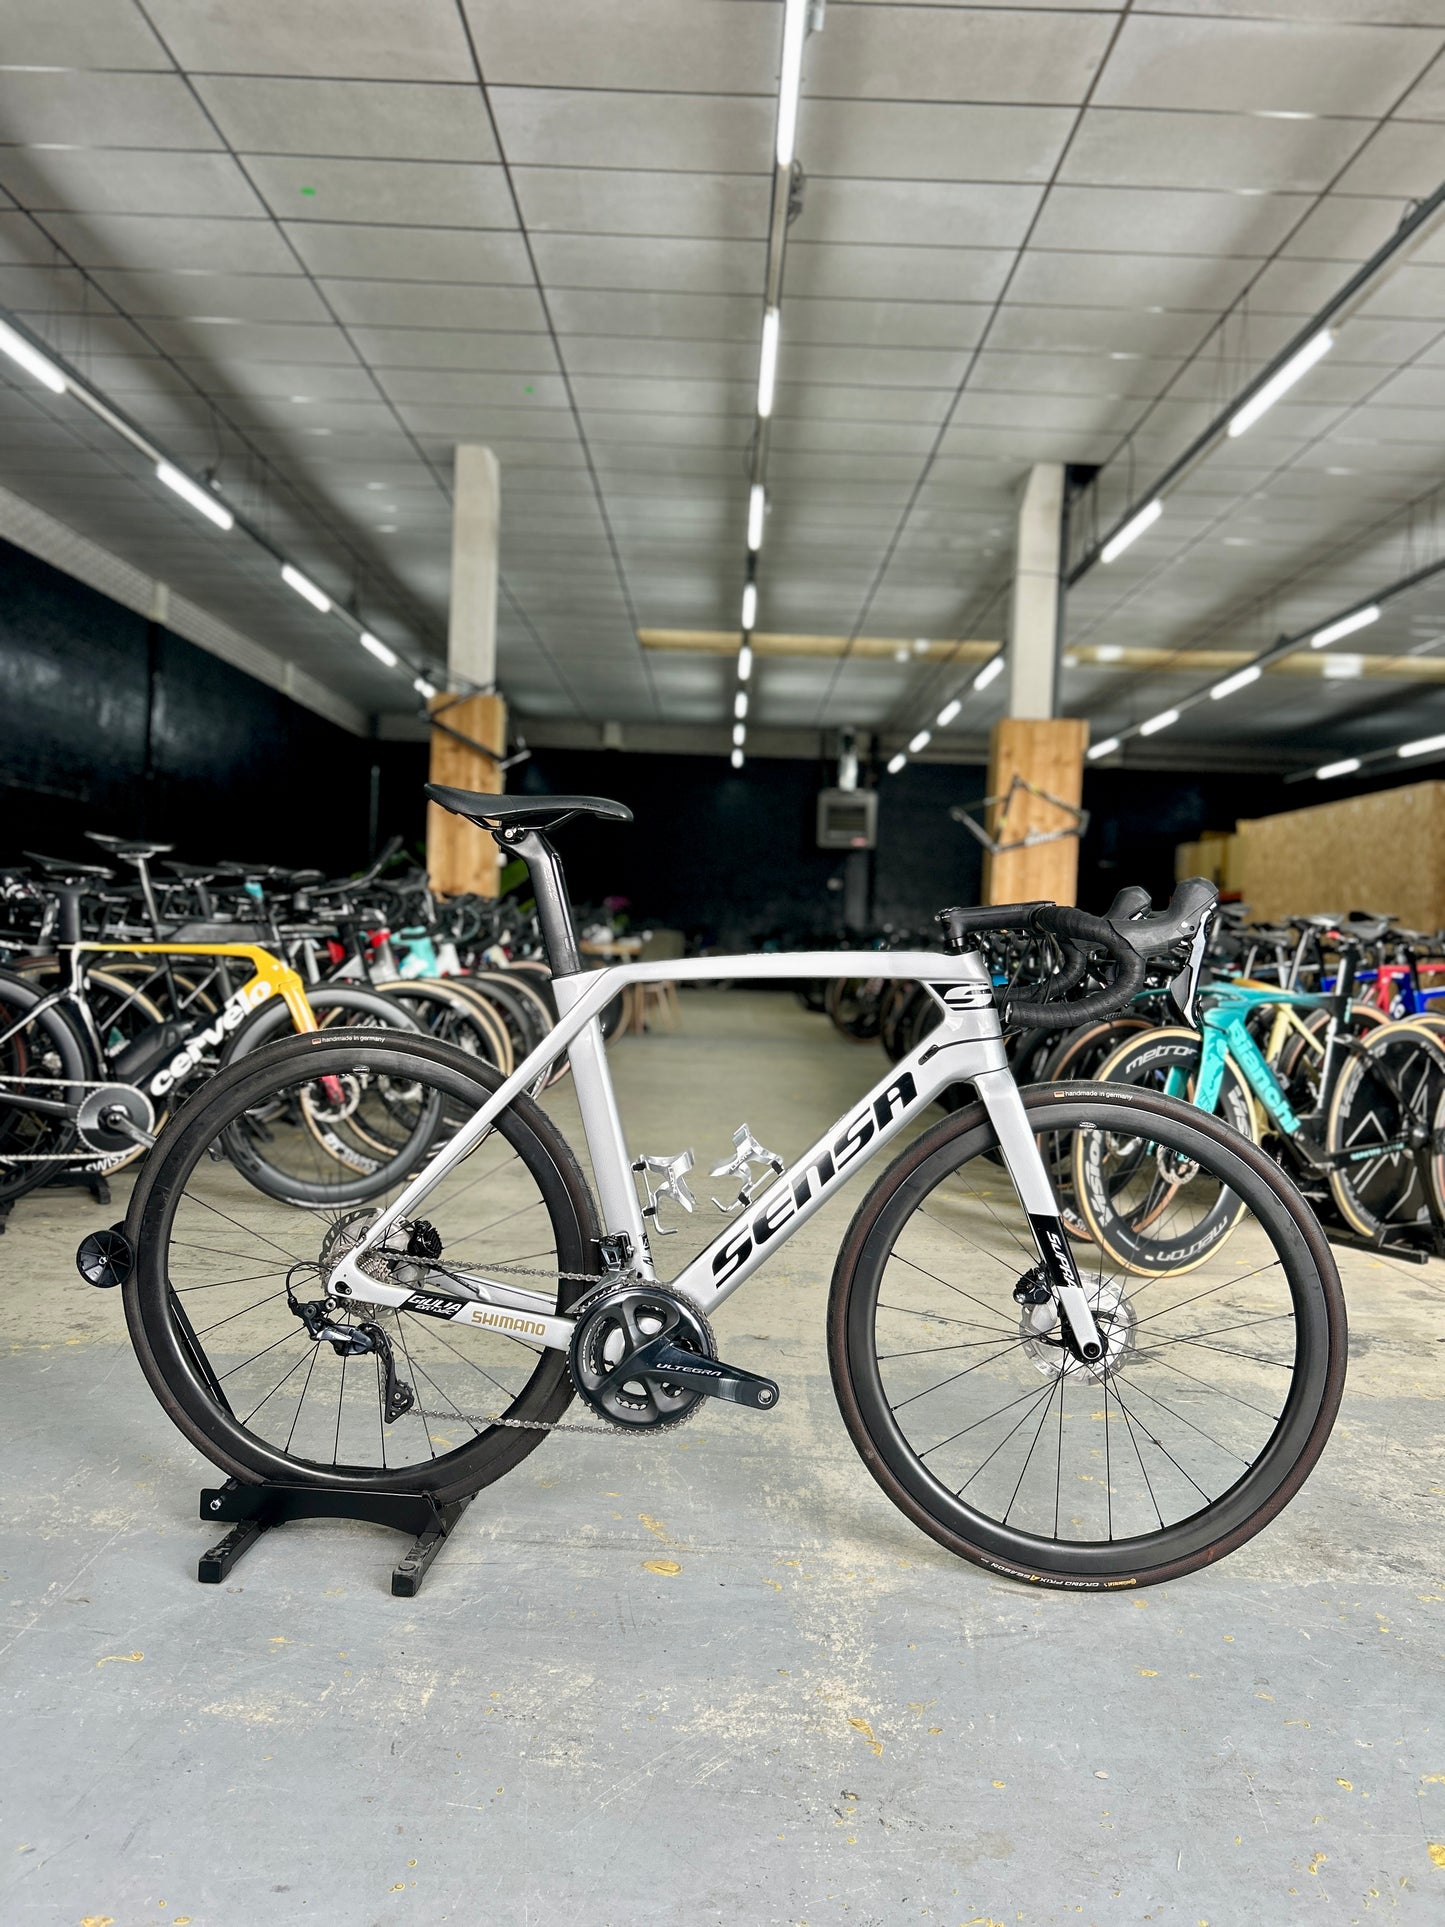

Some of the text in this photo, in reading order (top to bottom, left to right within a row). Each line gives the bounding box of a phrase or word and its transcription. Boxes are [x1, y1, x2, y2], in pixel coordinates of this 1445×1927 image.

[360, 1035, 386, 1043] germany
[1229, 1018, 1302, 1134] Bianchi
[1106, 1092, 1133, 1101] germany
[711, 1071, 918, 1290] SENSA
[1063, 1208, 1077, 1222] DT
[1156, 1215, 1228, 1261] metron
[1046, 1230, 1077, 1288] SUPRA
[408, 1295, 462, 1311] GIULIA
[472, 1311, 546, 1336] SHIMANO
[656, 1363, 722, 1377] ULTEGRA
[1040, 1577, 1064, 1586] PRIX
